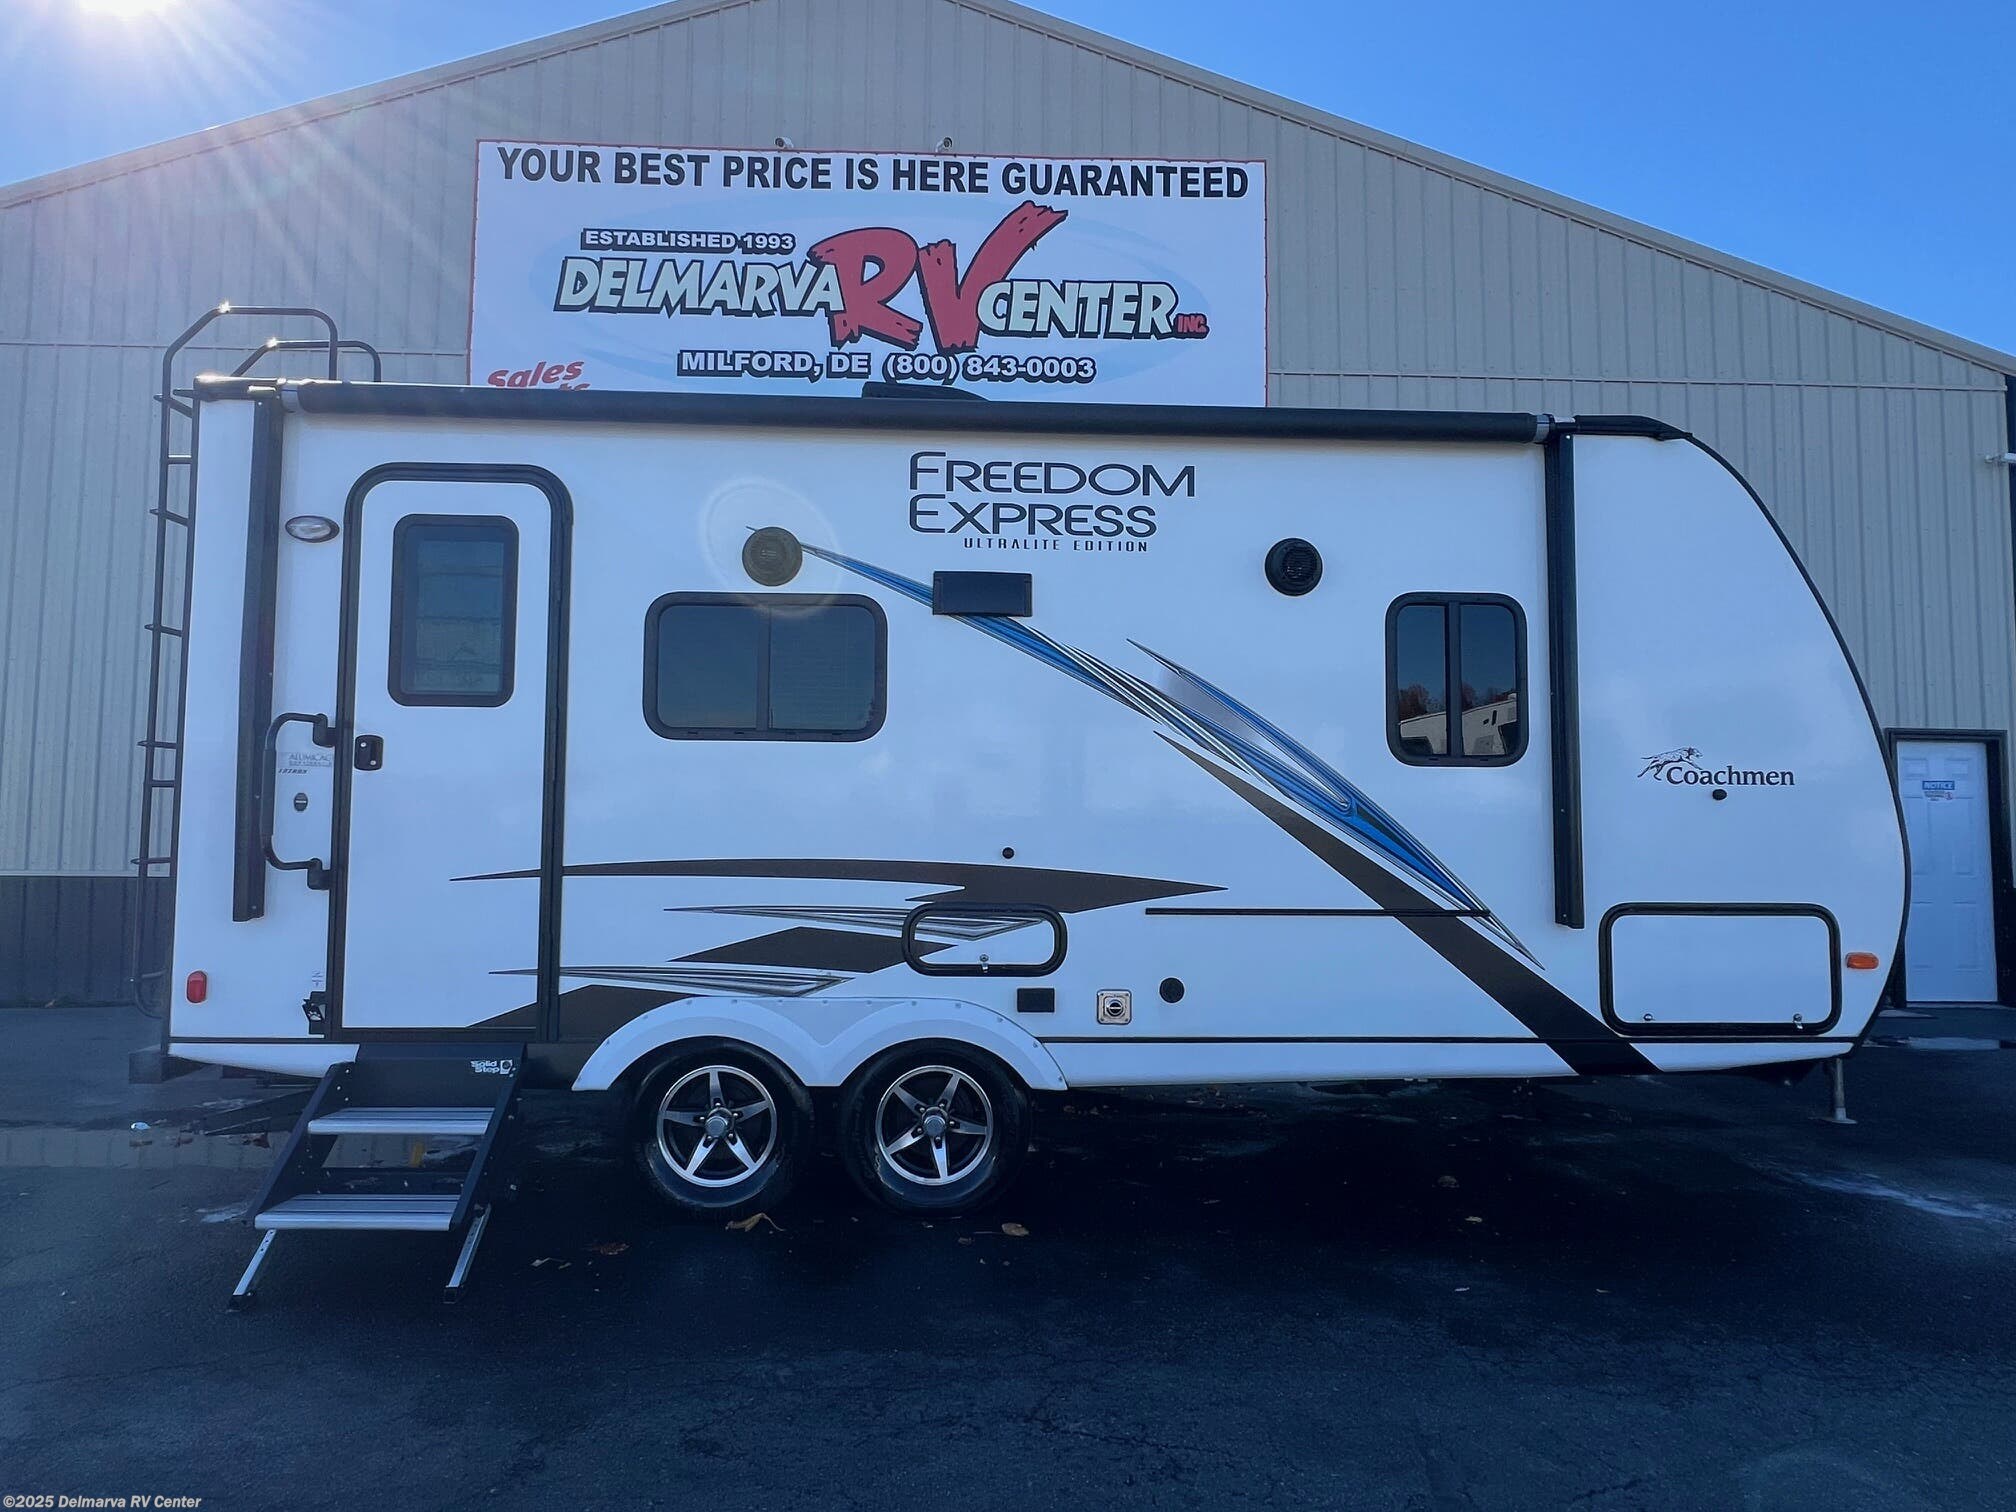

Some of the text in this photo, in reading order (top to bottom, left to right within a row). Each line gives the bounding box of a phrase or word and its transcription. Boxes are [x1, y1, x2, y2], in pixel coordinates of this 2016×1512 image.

[498, 147, 1249, 199] YOUR BEST PRICE IS HERE GUARANTEED
[583, 229, 796, 253] ESTABLISHED 1993
[555, 256, 846, 317] DELMARVA
[807, 200, 1068, 353] RV
[976, 278, 1179, 338] CENTER
[487, 361, 585, 389] sales
[680, 350, 1096, 381] MILFORD, DE (800) 843-0003
[909, 451, 1196, 498] FREEDOM
[909, 493, 1158, 538] EXPRESS
[963, 537, 1148, 552] ULTRALITE EDITION
[1666, 765, 1796, 786] Coachmen
[1923, 781, 1954, 790] NOTICE
